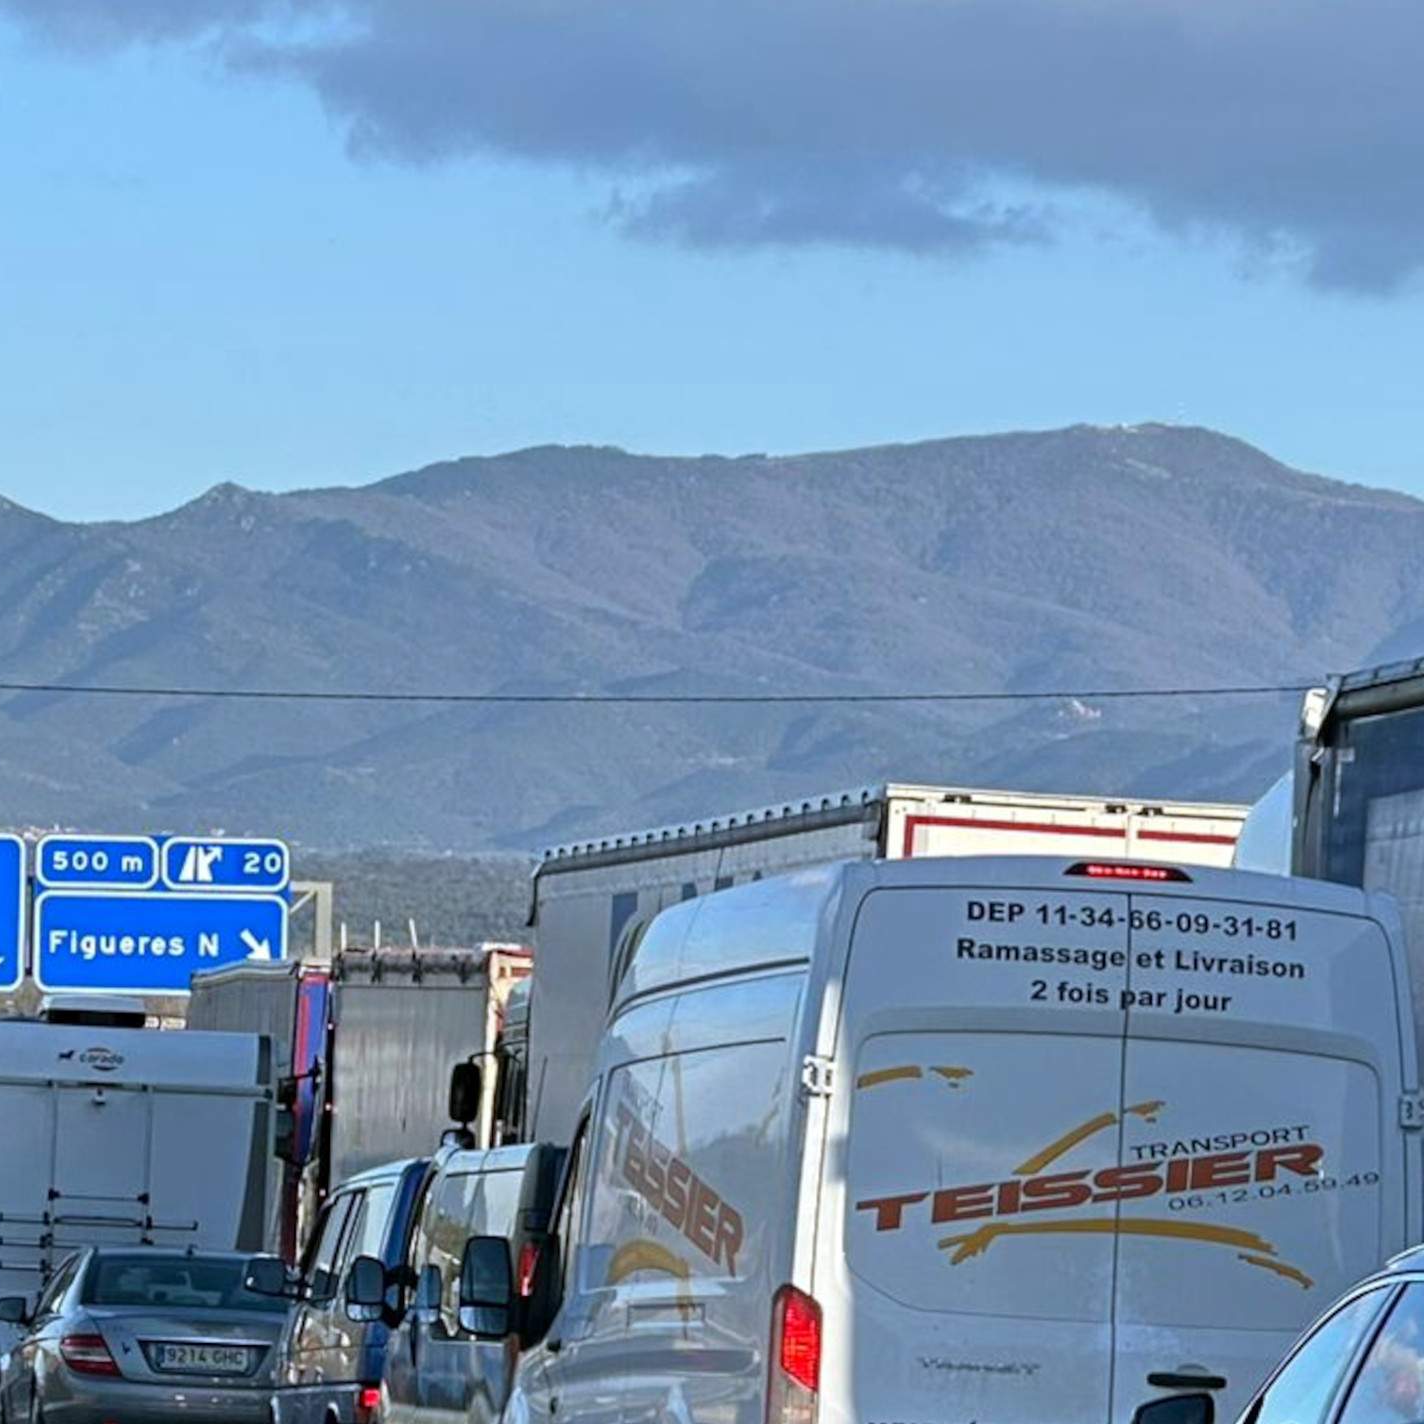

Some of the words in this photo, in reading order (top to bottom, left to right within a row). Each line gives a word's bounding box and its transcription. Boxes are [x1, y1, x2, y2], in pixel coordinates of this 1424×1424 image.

[52, 850, 109, 871] 500
[120, 855, 144, 873] m
[242, 851, 282, 874] 20
[966, 900, 1026, 923] DEP
[1035, 903, 1298, 942] 11-34-66-09-31-81
[48, 928, 185, 960] Figueres
[198, 931, 220, 958] N
[956, 938, 1126, 971] Ramassage
[1135, 951, 1166, 970] et
[1175, 951, 1306, 980] Livraison
[1030, 979, 1049, 1001] 2
[1057, 980, 1110, 1005] fois
[1120, 988, 1167, 1011] par
[1174, 986, 1233, 1015] jour
[1129, 1124, 1312, 1162] TRANSPORT
[855, 1143, 1326, 1233] TEISSIER
